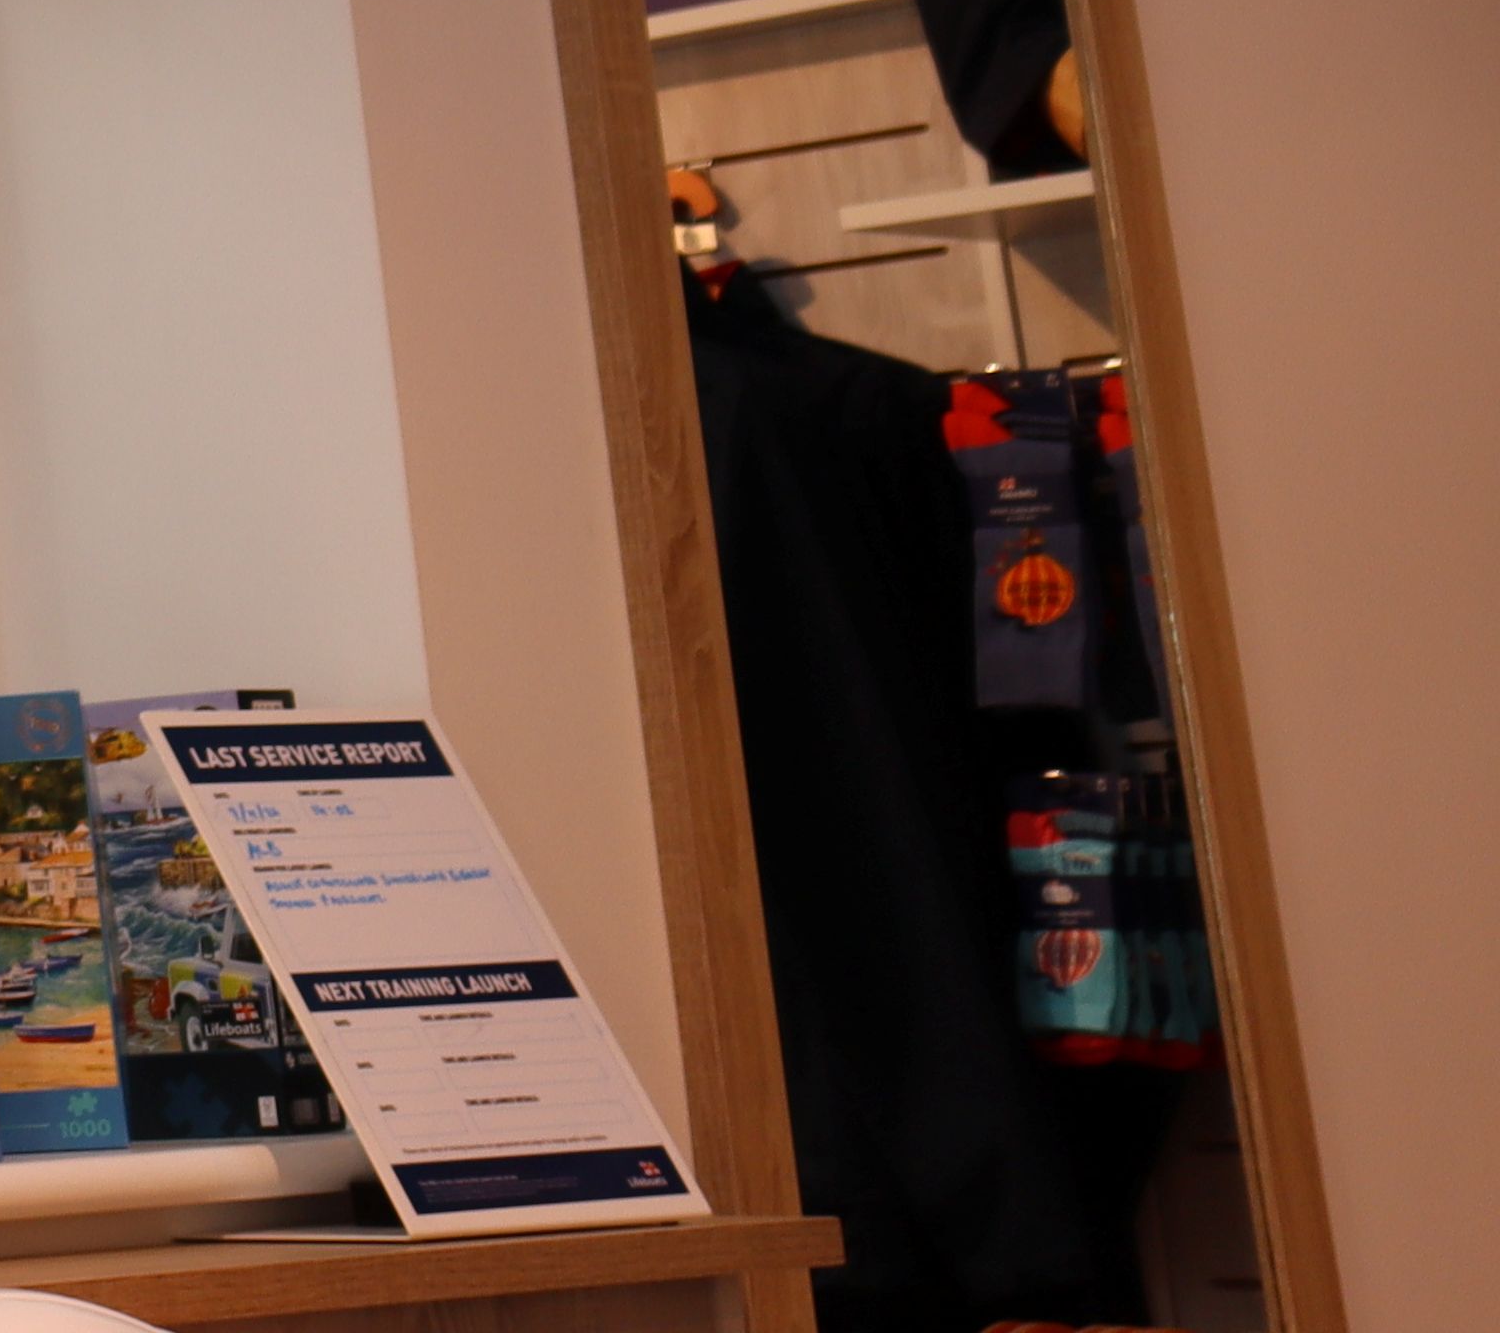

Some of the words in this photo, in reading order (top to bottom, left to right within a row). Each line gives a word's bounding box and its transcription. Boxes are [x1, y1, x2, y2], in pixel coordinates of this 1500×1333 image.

[189, 746, 248, 770] LAST
[249, 743, 343, 768] SERVICE
[342, 740, 427, 764] REPORT
[314, 980, 365, 1003] NEXT
[368, 976, 455, 1000] TRAINING
[455, 972, 533, 995] LAUNCH
[204, 1022, 262, 1037] Lifeboats
